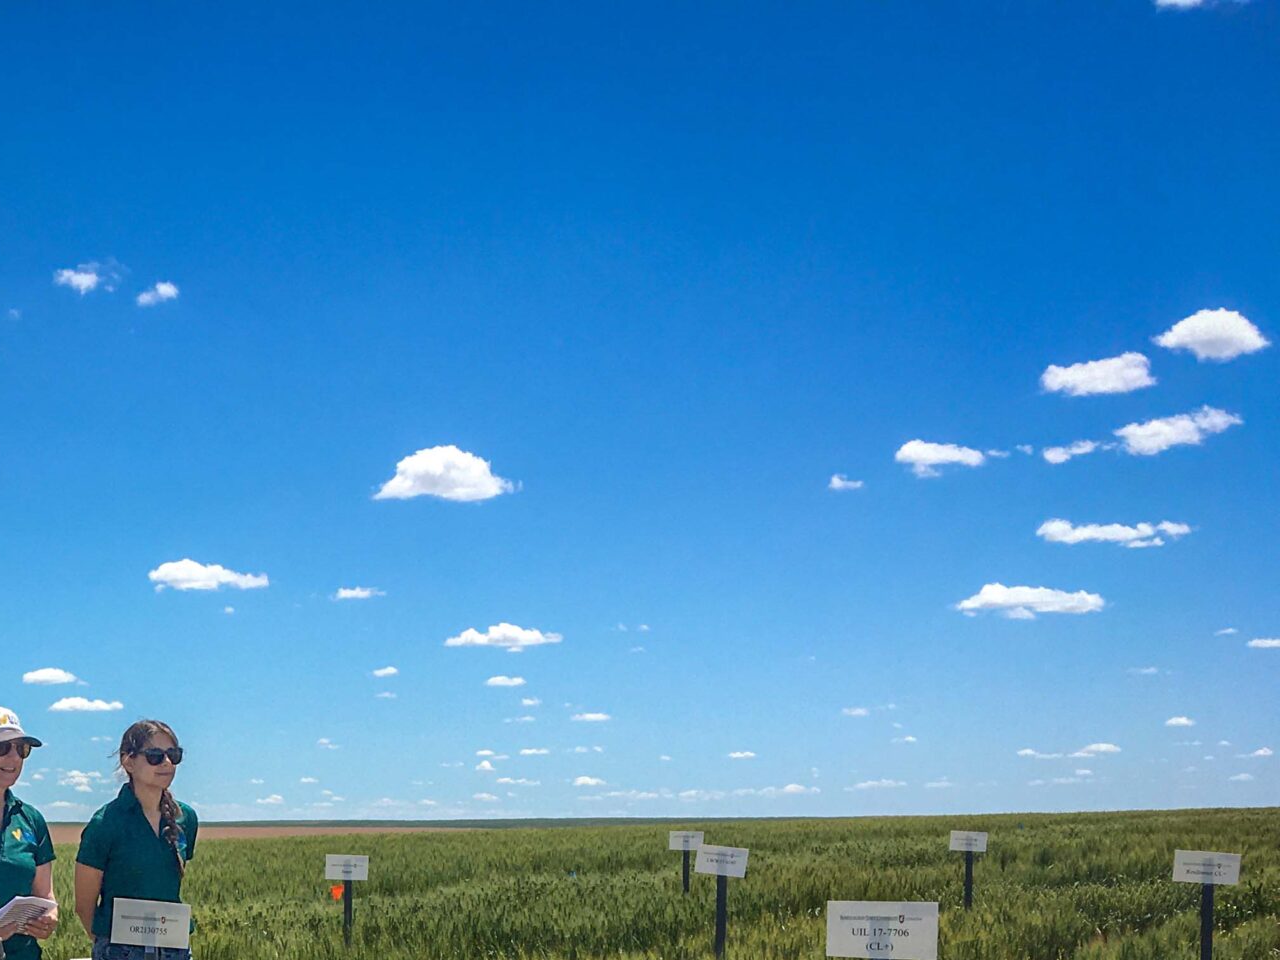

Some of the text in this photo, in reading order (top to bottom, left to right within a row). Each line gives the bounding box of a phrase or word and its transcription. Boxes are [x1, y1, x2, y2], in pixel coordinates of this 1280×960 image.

[852, 928, 910, 937] UIL 17-7706
[866, 942, 894, 952] (CL+)
